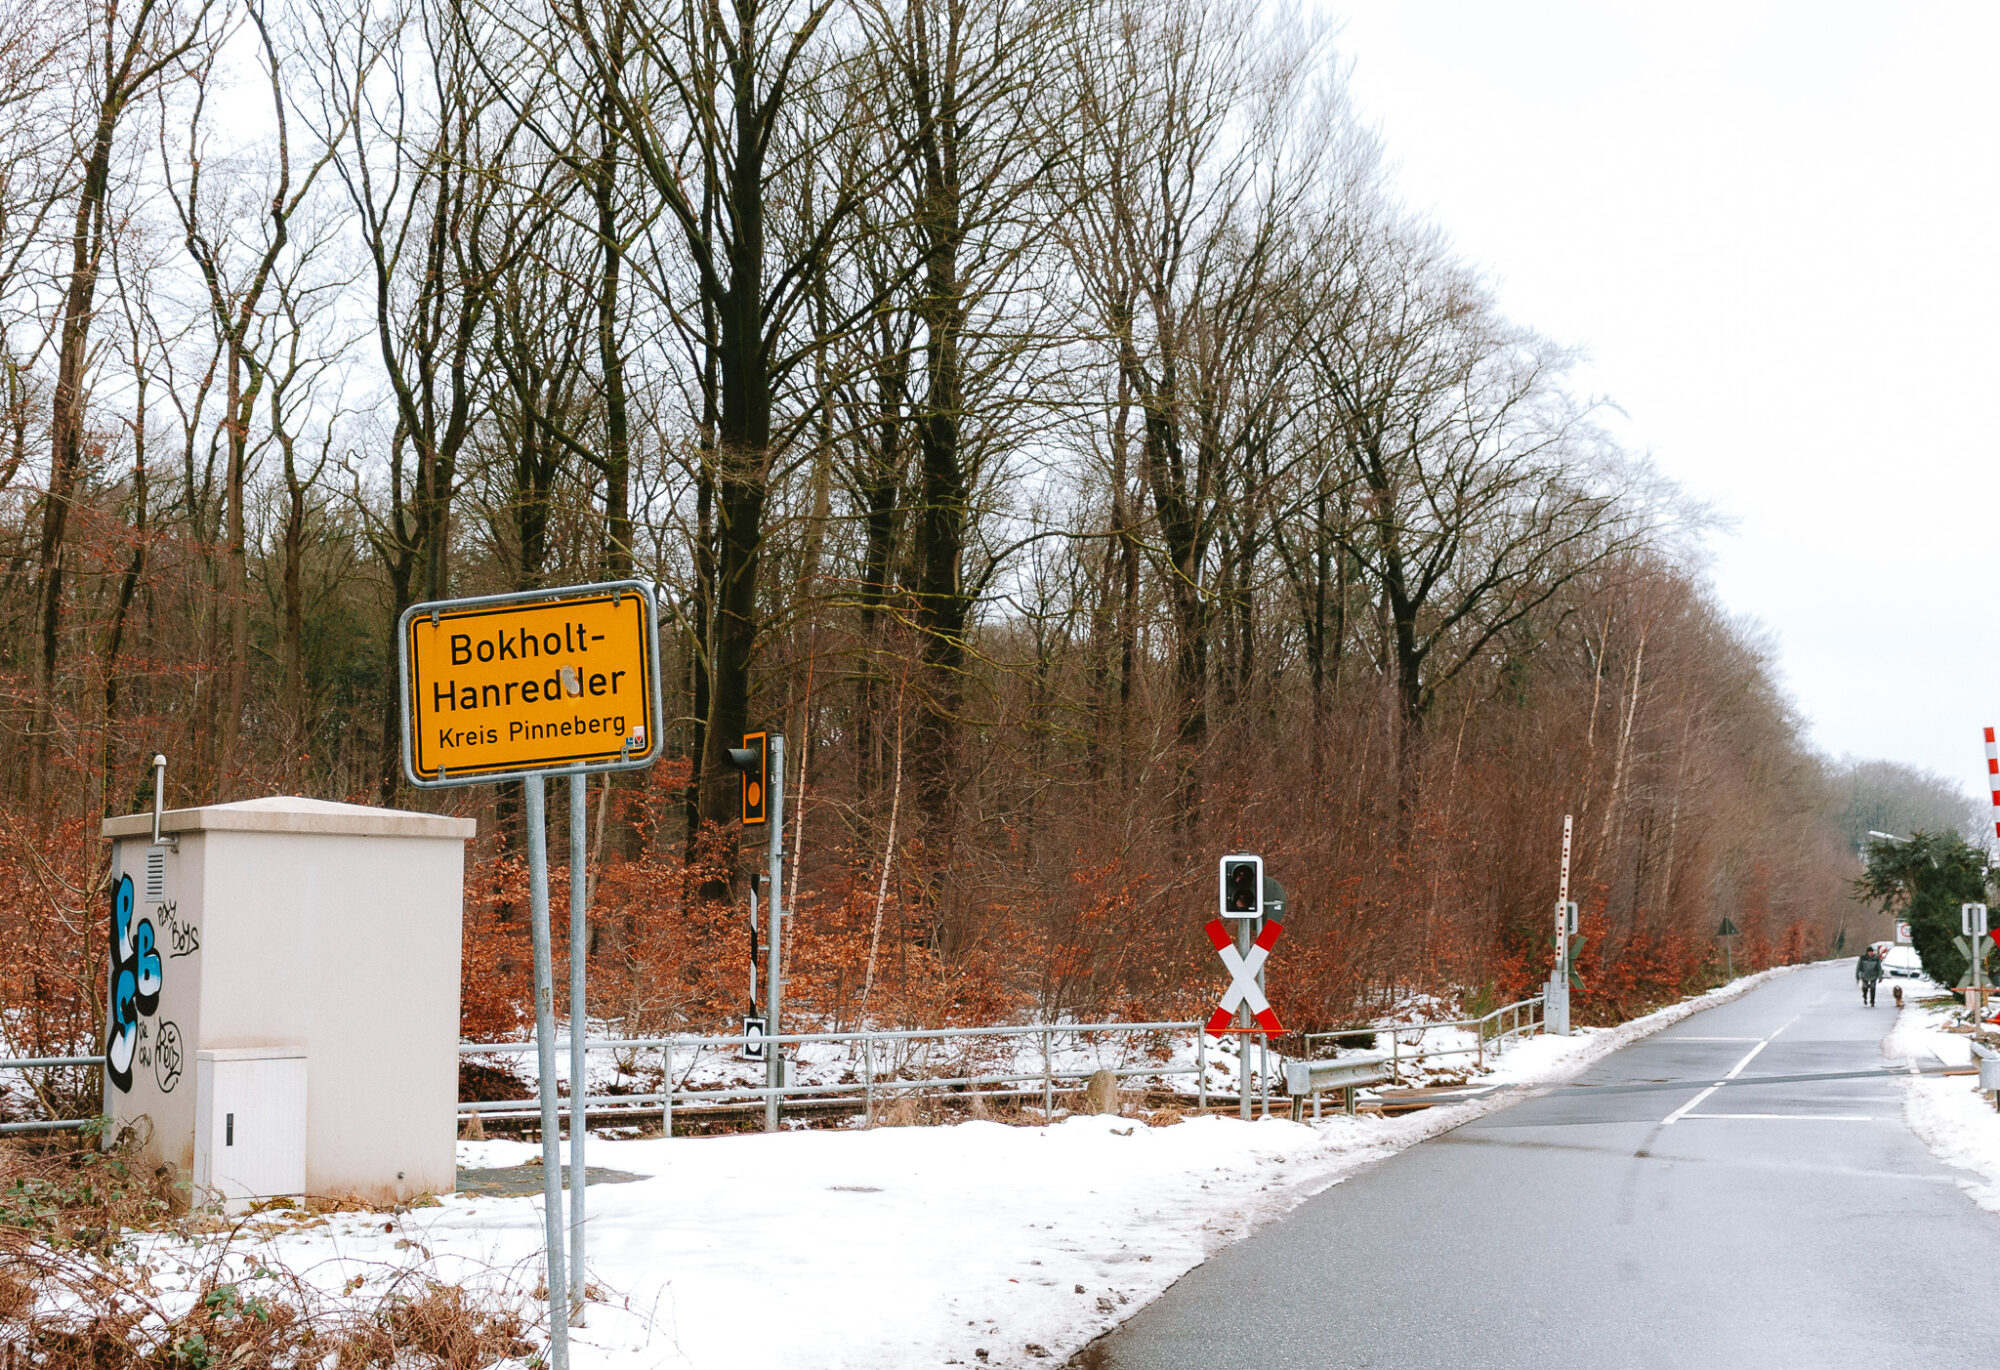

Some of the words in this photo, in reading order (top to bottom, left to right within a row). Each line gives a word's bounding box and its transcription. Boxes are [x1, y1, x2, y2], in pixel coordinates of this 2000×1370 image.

[450, 622, 605, 666] Bokholt-
[439, 724, 498, 749] Kreis
[509, 715, 625, 742] Pinneberg
